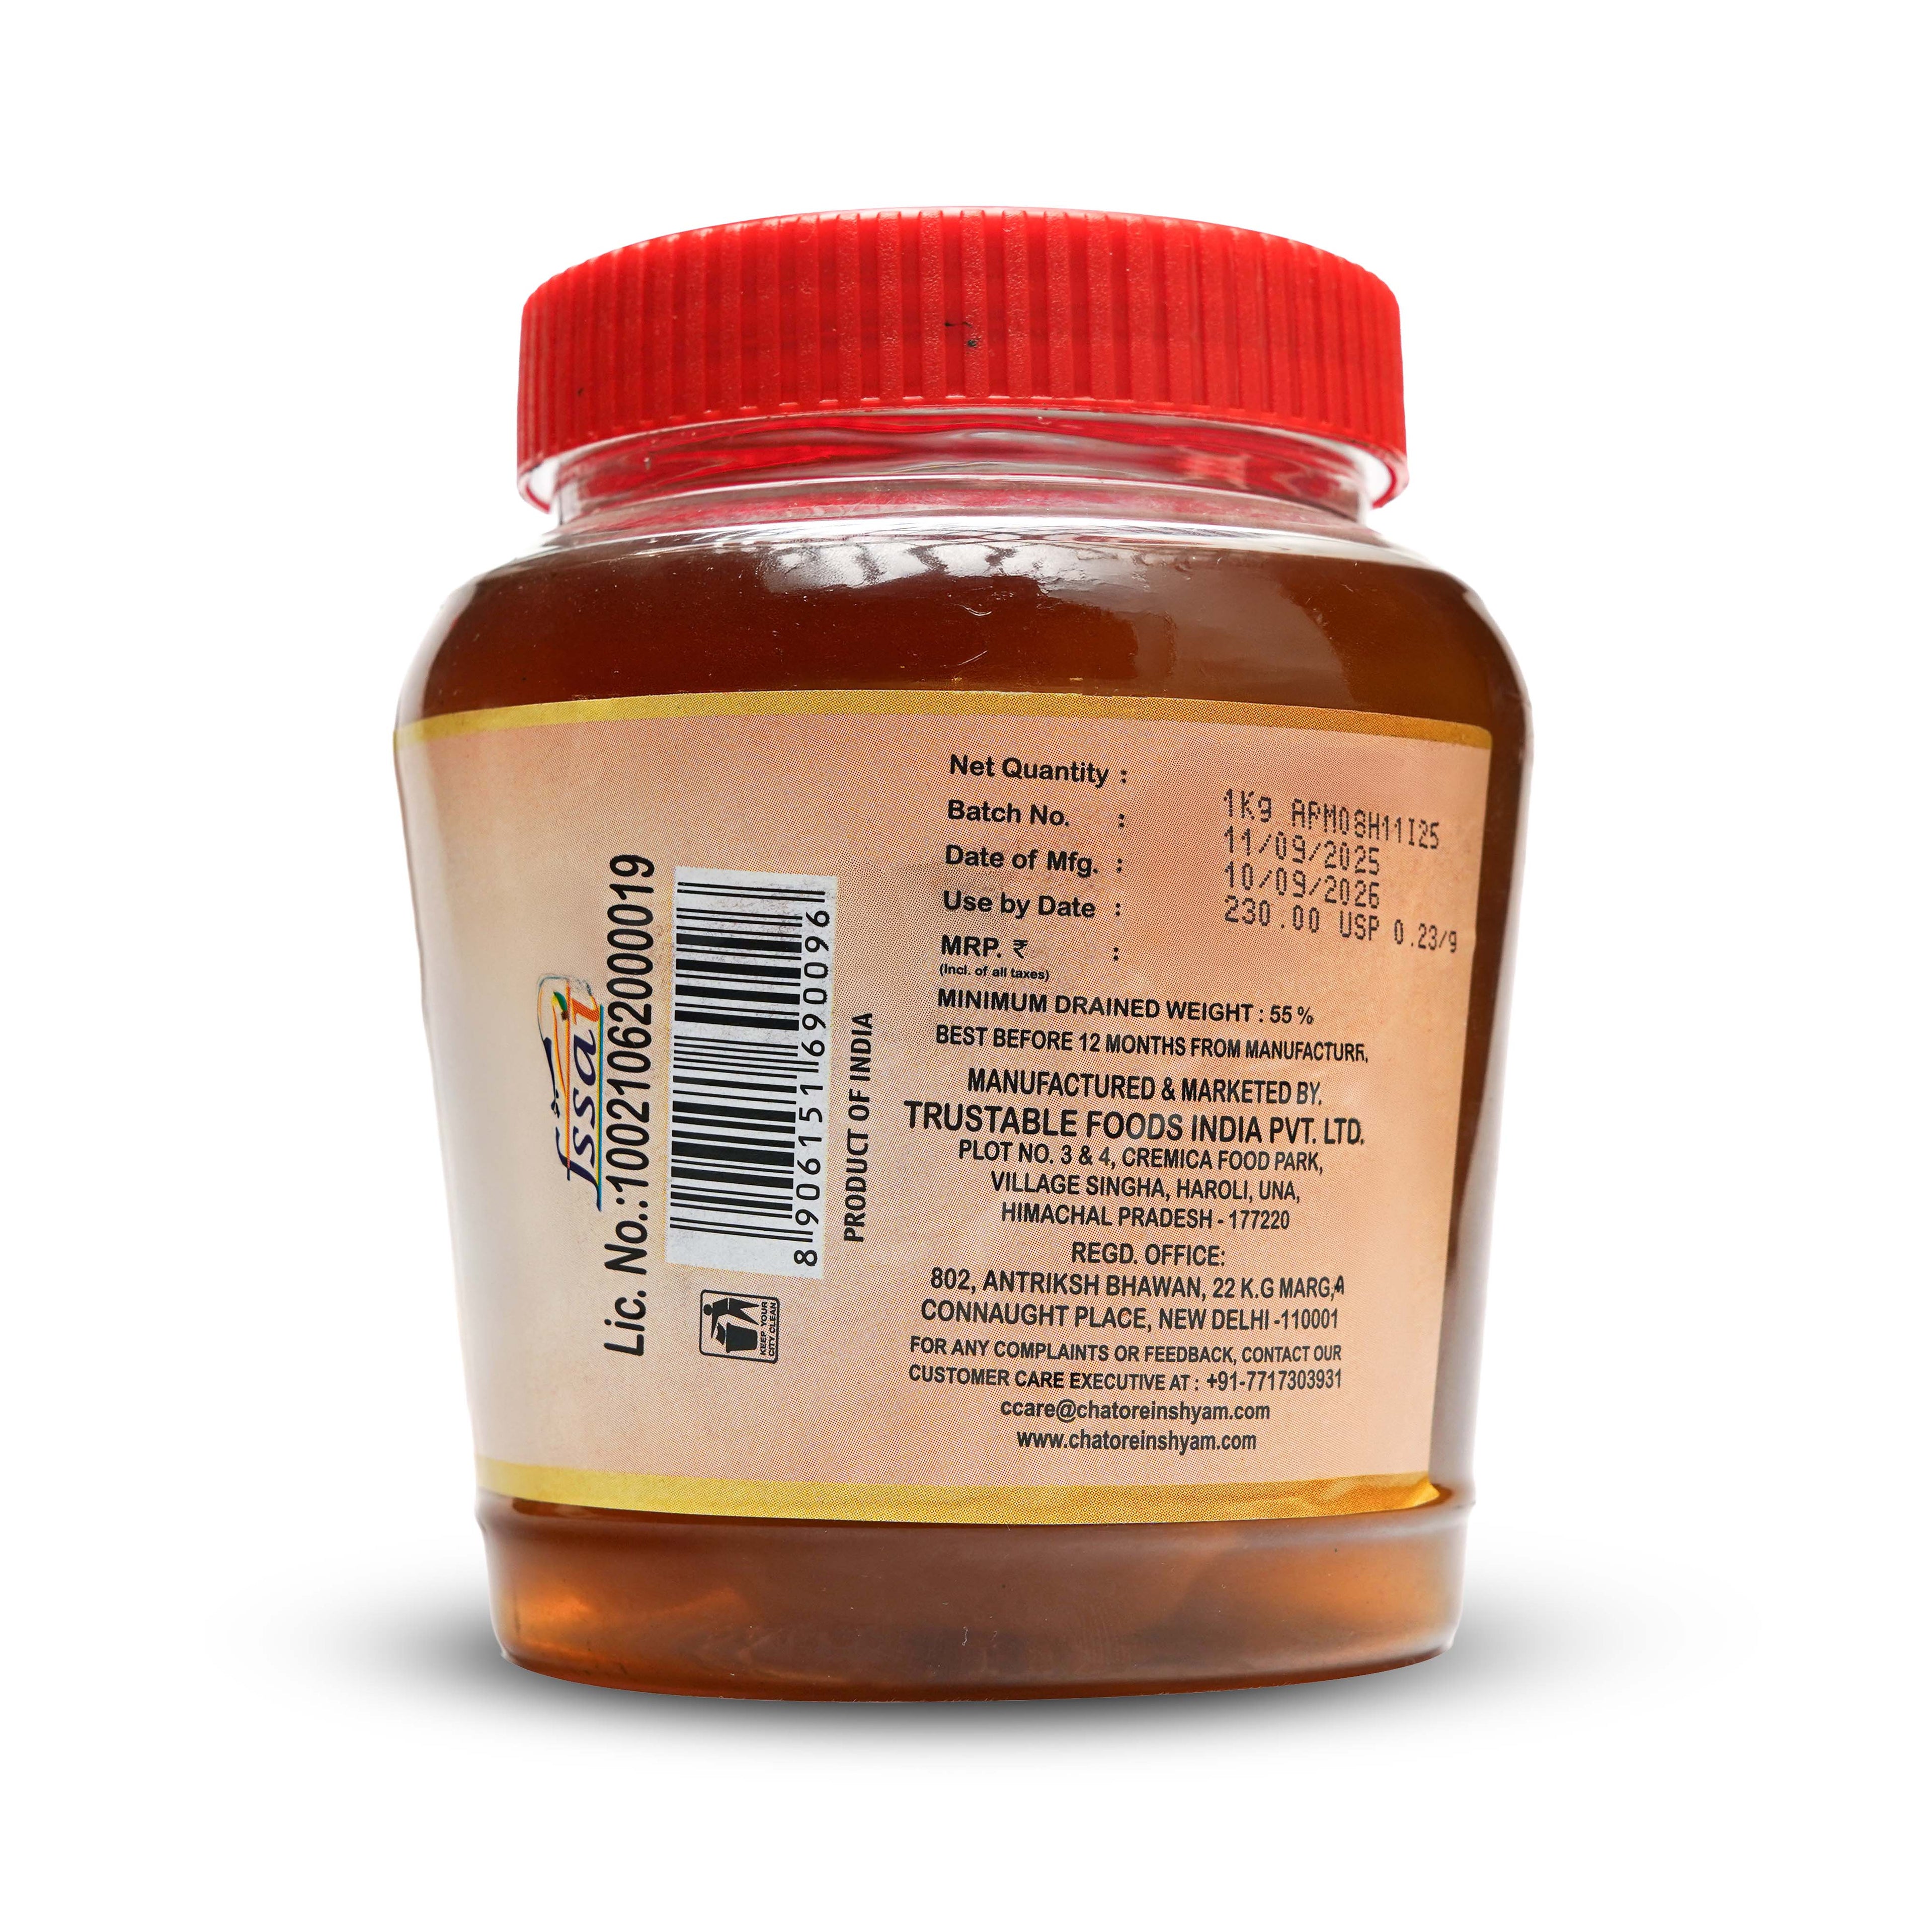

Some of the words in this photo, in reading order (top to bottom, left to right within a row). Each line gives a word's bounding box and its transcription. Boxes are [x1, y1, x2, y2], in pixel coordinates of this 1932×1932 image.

[950, 754, 995, 776] Net
[1002, 757, 1109, 788] Quantity
[947, 799, 1021, 824] Batch
[1030, 804, 1070, 827] No.
[1224, 788, 1271, 822] 1Kg
[946, 845, 1004, 868] Date
[1012, 849, 1037, 869] of
[1048, 851, 1099, 877] Mfg.
[1224, 826, 1379, 875] 11/09/2025
[1225, 861, 1379, 909] 10/09/2026
[943, 891, 993, 913] Use
[1001, 892, 1030, 919] by
[1038, 896, 1096, 918] Date
[1225, 895, 1319, 933] 230.00
[1339, 911, 1379, 941] USP
[941, 935, 1002, 958] MRP.
[1013, 939, 1027, 959] ₹
[939, 964, 971, 977] (Incl.
[975, 966, 988, 977] of
[992, 967, 1006, 977] all
[1010, 968, 1049, 981] taxes)
[938, 988, 1047, 1013] MINIMUM
[1055, 995, 1160, 1018] DRAINED
[1166, 1001, 1254, 1022] WEIGHT
[1270, 1006, 1292, 1023] 55
[1298, 1006, 1314, 1024] %
[848, 1012, 873, 1081] INDIA
[936, 1024, 988, 1045] BEST
[994, 1028, 1073, 1051] BEFORE
[1079, 1032, 1100, 1052] 12
[1106, 1033, 1186, 1057] MONTHS
[1191, 1037, 1240, 1058] FROM
[968, 1068, 1155, 1100] MANUFACTURED
[1161, 1077, 1176, 1101] &
[1182, 1078, 1292, 1104] MARKETED
[555, 995, 602, 1212] fssai
[848, 1089, 870, 1121] OF
[904, 1100, 1078, 1137] TRUSTABLE
[1086, 1110, 1183, 1141] FOODS
[1191, 1114, 1262, 1143] INDIA
[1270, 1116, 1316, 1144] PVT.
[1324, 1117, 1365, 1146] LTD.
[959, 1139, 1013, 1162] PLOT
[1019, 1143, 1054, 1164] NO.
[1061, 1145, 1072, 1164] 3
[1078, 1145, 1092, 1165] &
[1099, 1147, 1115, 1169] 4,
[1122, 1147, 1213, 1170] CREMICA
[1218, 1150, 1270, 1171] FOOD
[1274, 1152, 1323, 1174] PARK,
[844, 1128, 869, 1242] PRODUCT
[991, 1171, 1079, 1195] VILLAGE
[1086, 1175, 1170, 1202] SINGHA,
[1176, 1179, 1253, 1203] HAROLI,
[1259, 1180, 1300, 1203] UNA,
[1002, 1202, 1112, 1227] HIMACHAL
[1119, 1206, 1213, 1229] PRADESH
[1229, 1210, 1290, 1230] 177220
[1072, 1242, 1138, 1264] REGD.
[1145, 1244, 1225, 1267] OFFICE:
[930, 1267, 976, 1294] 802,
[983, 1270, 1099, 1296] ANTRIKSH
[1107, 1275, 1206, 1302] BHAWAN,
[1213, 1277, 1235, 1299] 22
[1241, 1276, 1274, 1299] K.G
[604, 1289, 647, 1356] Lic.
[921, 1299, 1069, 1327] CONNAUGHT
[1075, 1306, 1152, 1333] PLACE,
[1159, 1308, 1207, 1330] NEW
[1212, 1308, 1268, 1330] DELHI
[910, 1336, 947, 1354] FOR
[951, 1339, 991, 1356] ANY
[994, 1340, 1108, 1361] COMPLAINTS
[1114, 1345, 1139, 1361] OR
[1145, 1345, 1236, 1365] FEEDBACK,
[1242, 1345, 1311, 1362] CONTACT
[1314, 1345, 1341, 1360] OUR
[909, 1364, 1010, 1386] CUSTOMER
[1015, 1371, 1065, 1389] CARE
[1070, 1372, 1165, 1390] EXECUTIVE
[1169, 1374, 1190, 1390] AT
[1207, 1368, 1341, 1392] +91-7717303931
[1001, 1398, 1270, 1424] ccare@chatoreinshyam.com
[1016, 1428, 1256, 1456] www.chatoreinshyam.com
